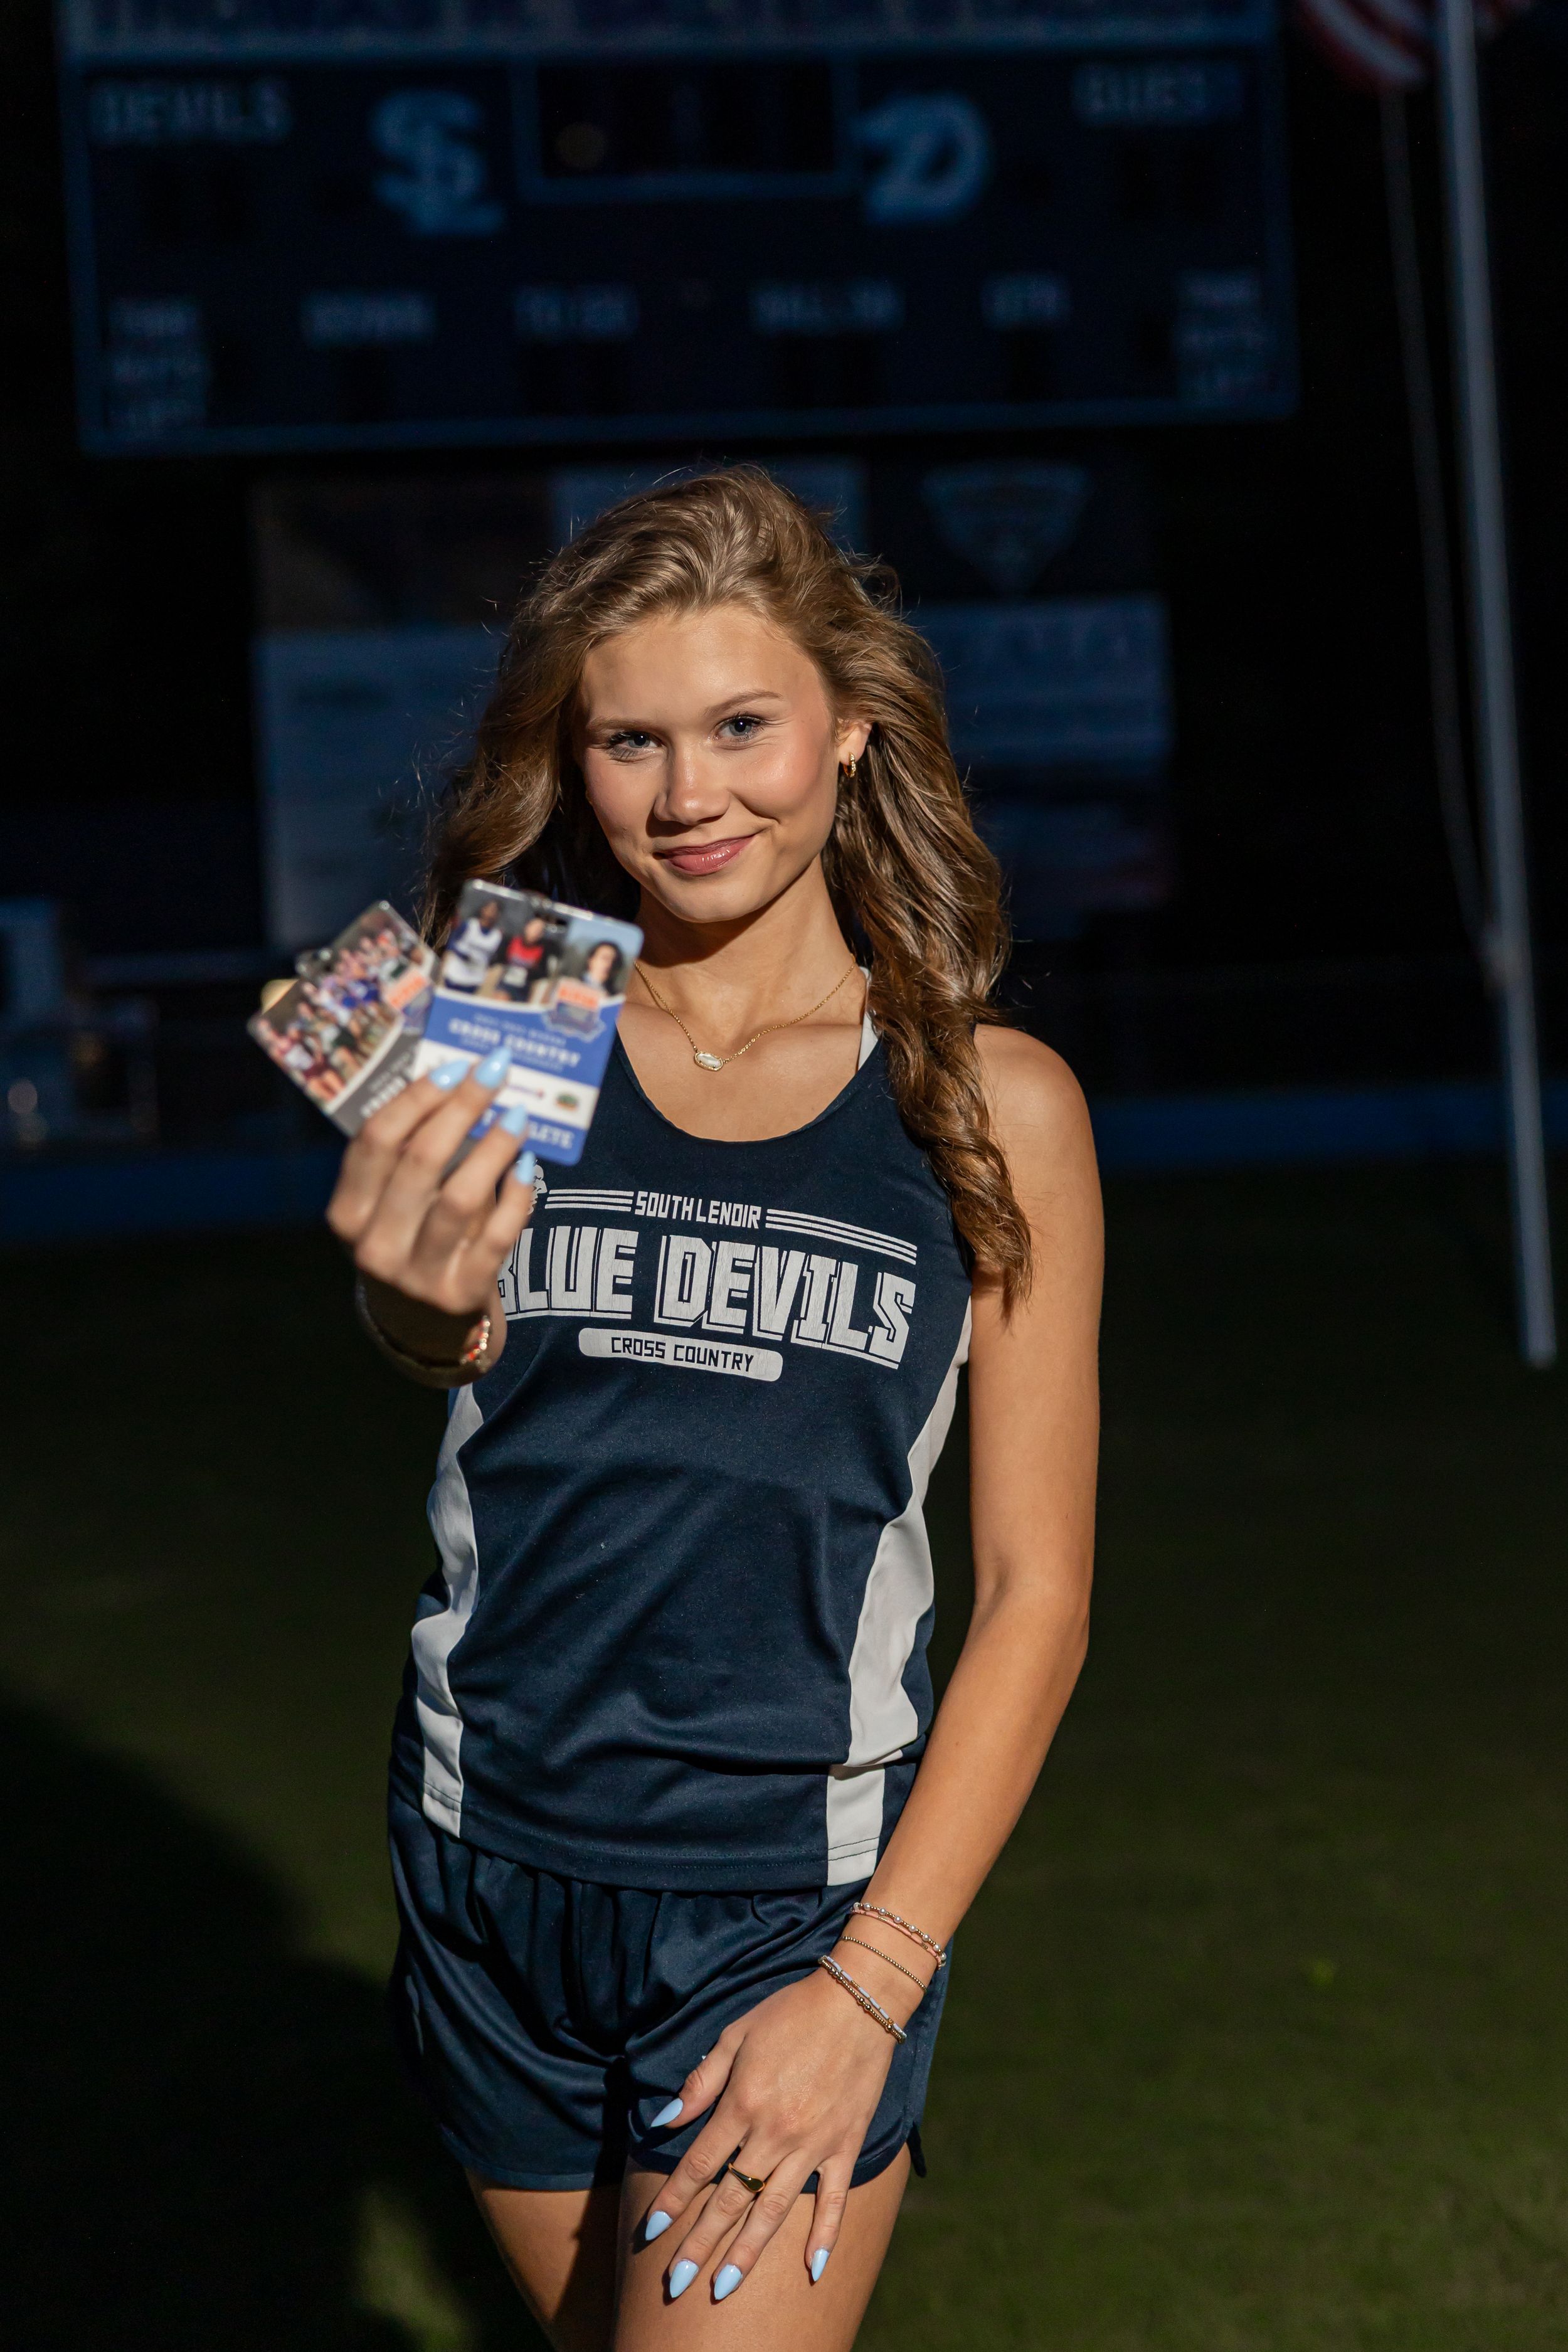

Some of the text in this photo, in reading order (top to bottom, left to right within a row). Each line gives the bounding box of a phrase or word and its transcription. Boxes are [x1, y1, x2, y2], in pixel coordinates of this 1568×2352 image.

[94, 82, 285, 140] DEVILS
[635, 1191, 761, 1229] SOUTH LENOIR
[654, 1235, 917, 1370] DEVILS
[611, 1337, 755, 1372] CROSS COUNTRY
